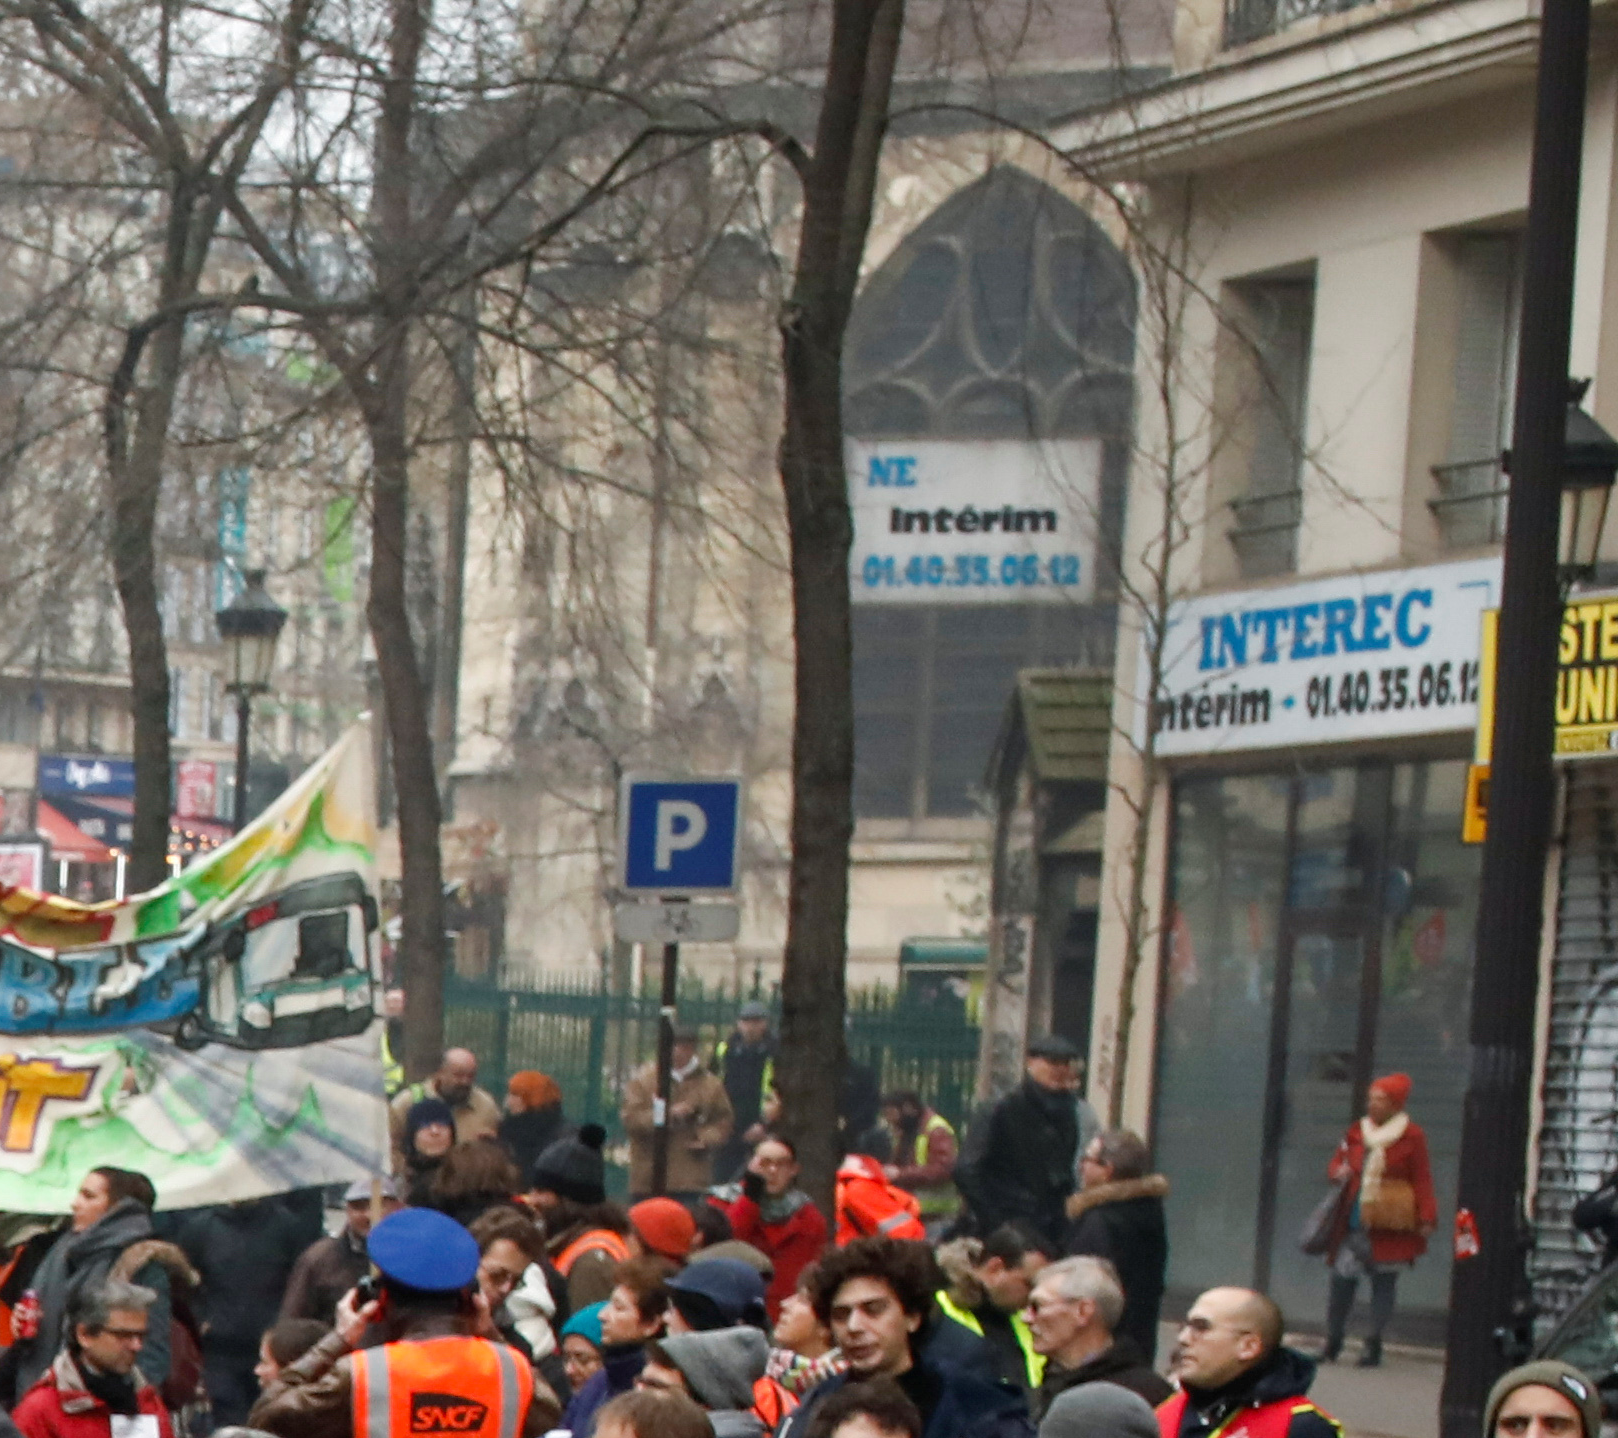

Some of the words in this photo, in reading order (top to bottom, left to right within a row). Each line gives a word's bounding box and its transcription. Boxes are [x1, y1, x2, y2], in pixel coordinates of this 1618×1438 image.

[889, 505, 1058, 536] Intérim
[1199, 589, 1433, 671] INTEREC
[1153, 683, 1271, 733] ntérim
[653, 798, 708, 871] P
[412, 1405, 484, 1430] SNCF
